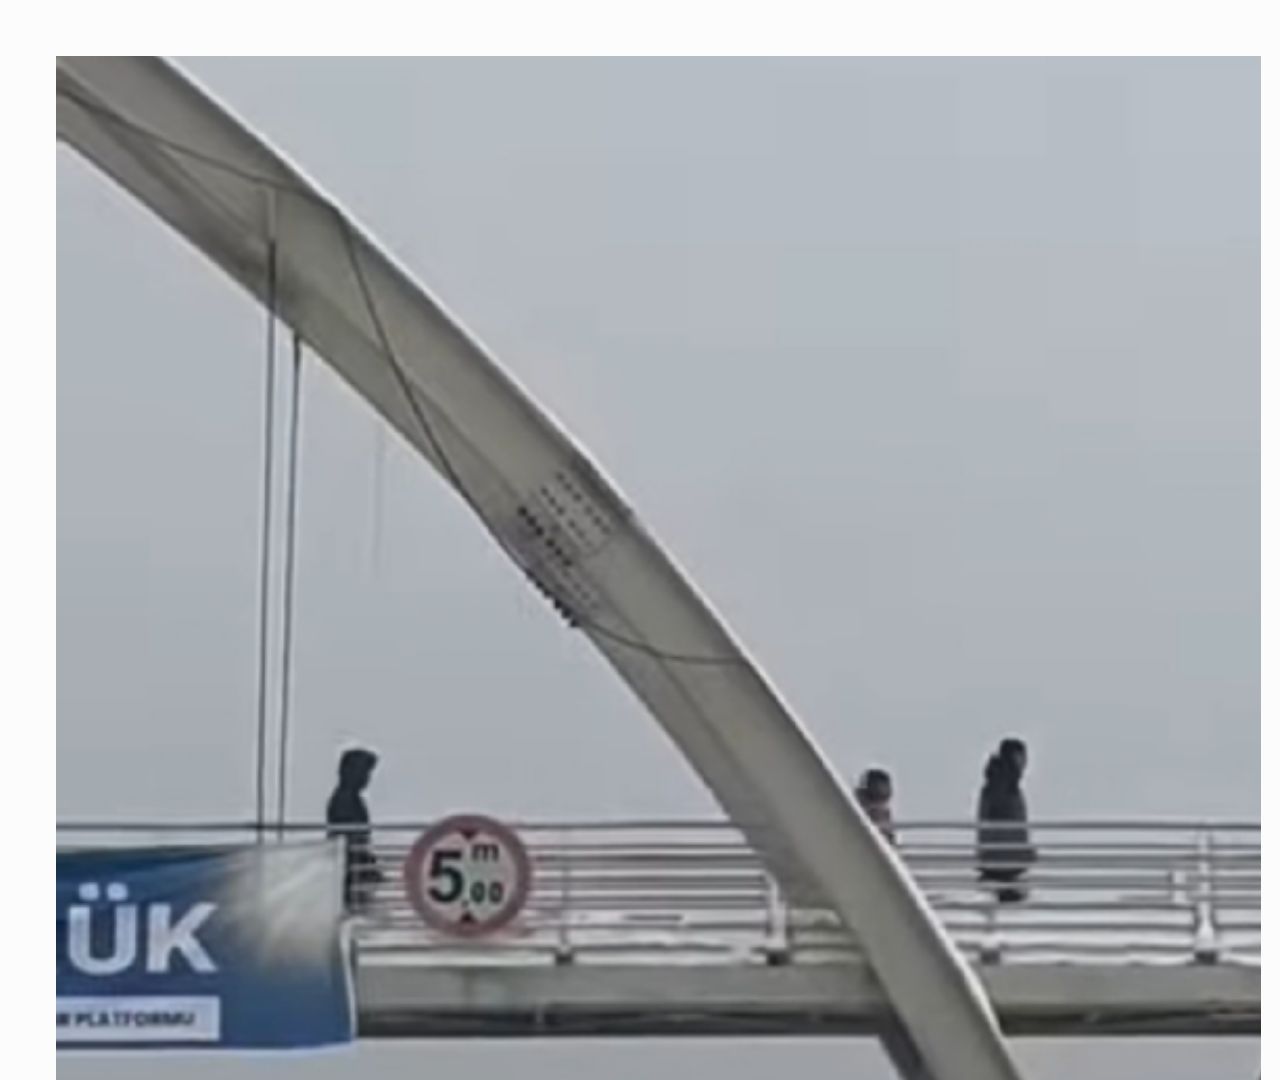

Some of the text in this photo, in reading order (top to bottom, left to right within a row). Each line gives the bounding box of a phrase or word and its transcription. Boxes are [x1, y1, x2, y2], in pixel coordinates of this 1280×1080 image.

[428, 849, 463, 903] 5
[68, 882, 218, 976] ÜK
[75, 1011, 196, 1027] PLATFORMU
